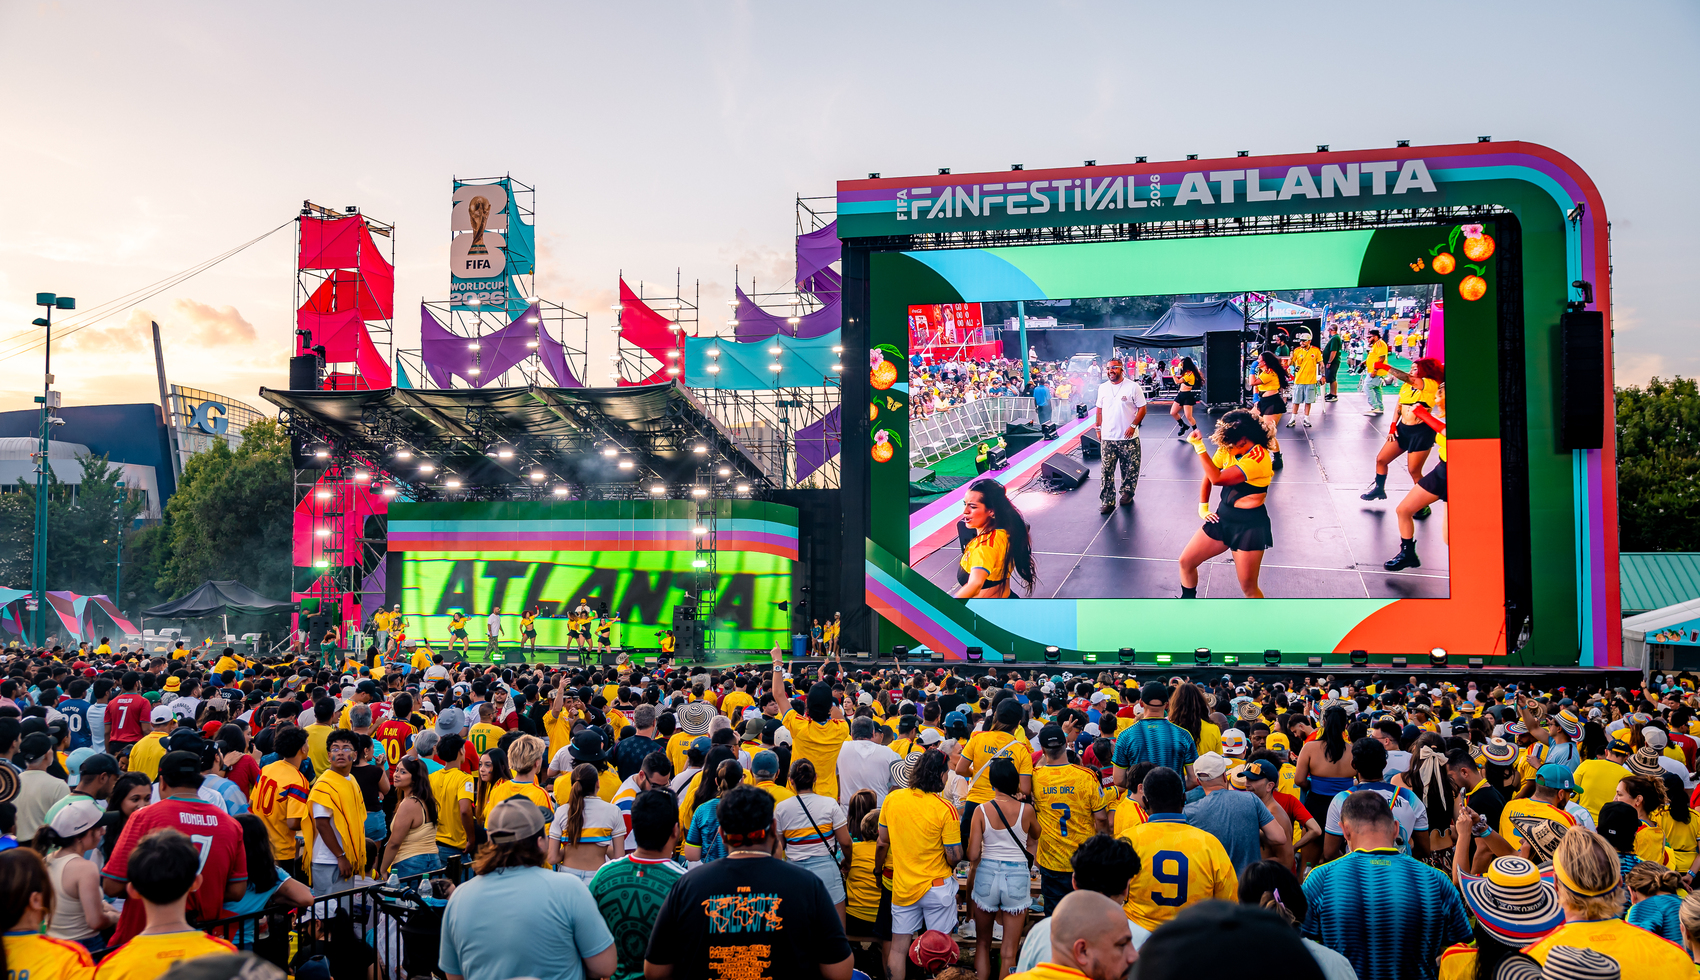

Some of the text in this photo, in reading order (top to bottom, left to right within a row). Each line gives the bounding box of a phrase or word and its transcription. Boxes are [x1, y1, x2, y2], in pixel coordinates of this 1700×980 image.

[1150, 174, 1161, 207] 2026
[1173, 159, 1436, 206] ATLANTA
[897, 189, 908, 220] FIFA
[466, 259, 491, 270] FIFA
[434, 560, 756, 632] ATLANTA
[425, 653, 434, 666] 9
[118, 706, 129, 729] 7
[380, 738, 401, 765] 10
[471, 733, 487, 755] 10
[679, 739, 690, 747] LUIS
[984, 744, 998, 755] LUIS
[256, 775, 277, 817] 10
[1043, 784, 1075, 795] LUIS DÍAZ
[179, 812, 218, 827] RONALDO
[1051, 803, 1070, 837] 7
[190, 834, 214, 875] 7
[1150, 850, 1189, 907] 9
[709, 894, 744, 934] WORLD
[745, 893, 766, 933] CUP
[749, 944, 771, 952] City
